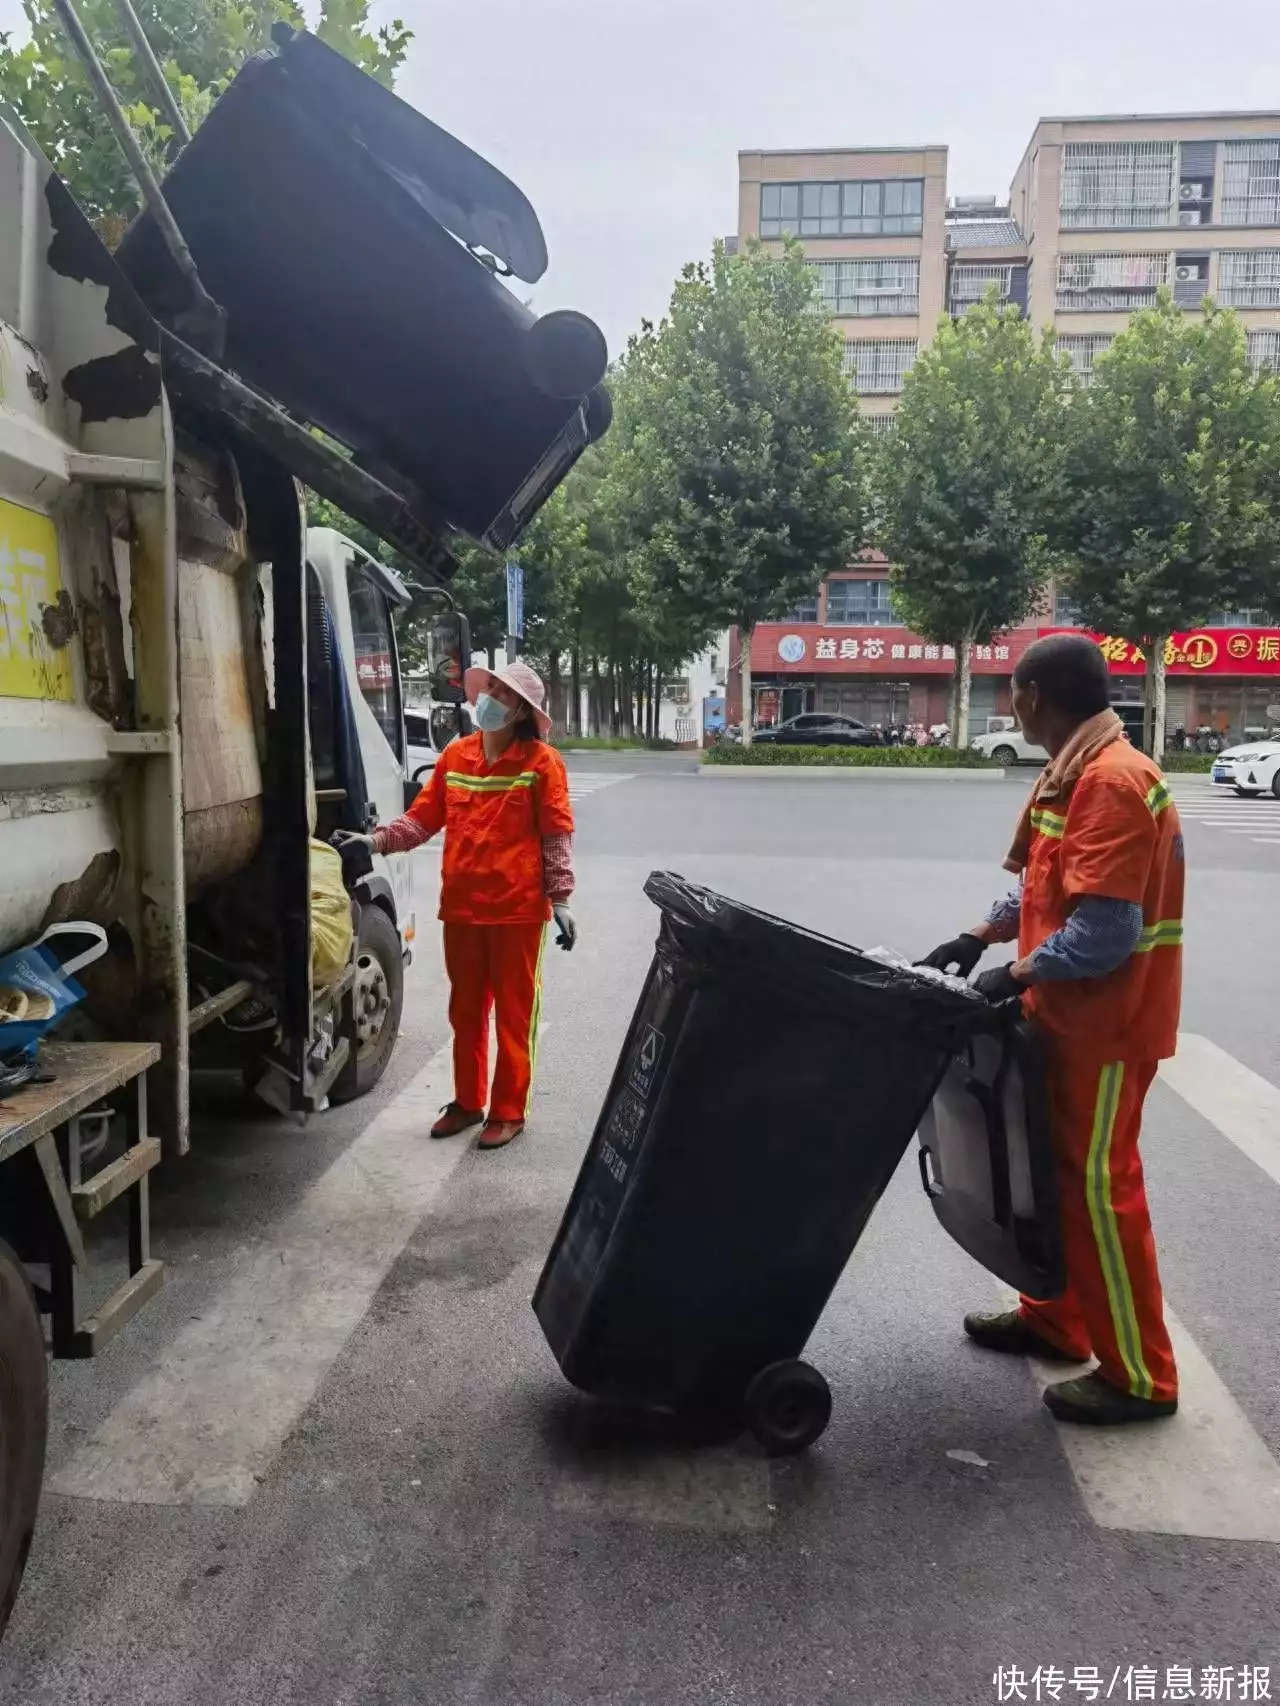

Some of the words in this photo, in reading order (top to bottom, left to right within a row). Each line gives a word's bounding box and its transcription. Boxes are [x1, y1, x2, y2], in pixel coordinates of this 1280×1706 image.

[815, 637, 885, 659] 益身芯
[1256, 636, 1280, 661] 振
